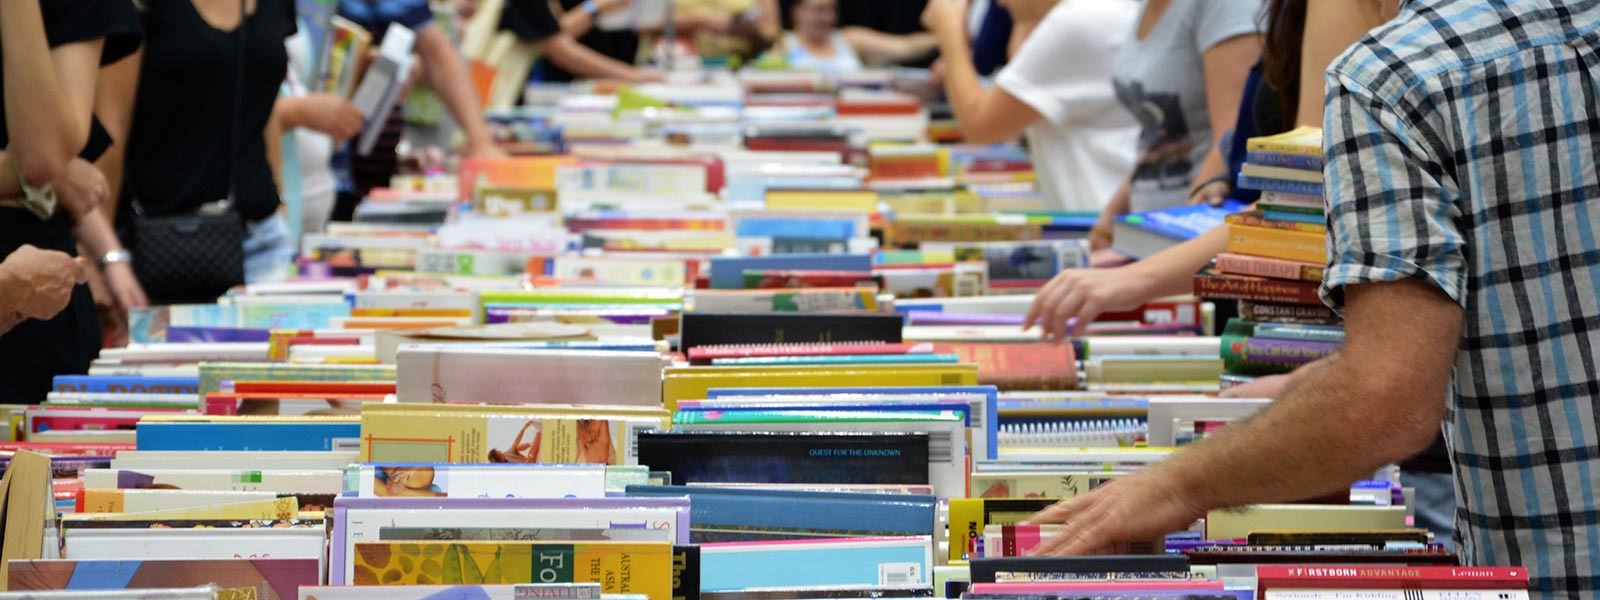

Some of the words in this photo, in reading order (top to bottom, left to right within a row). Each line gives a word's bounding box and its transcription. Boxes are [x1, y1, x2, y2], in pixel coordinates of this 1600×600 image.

[1220, 257, 1250, 272] ANGEL
[1252, 260, 1297, 278] THERAPY
[1200, 278, 1219, 290] The
[1220, 279, 1239, 290] Art
[1253, 304, 1295, 316] CONSTANT
[809, 448, 831, 457] QUEST
[833, 448, 847, 457] FOR
[849, 448, 862, 457] THE
[863, 448, 901, 457] UNKNOWN
[591, 558, 600, 575] THE
[1297, 568, 1357, 577] FIRSTBORN
[1360, 568, 1421, 577] ADVANTAGE
[605, 570, 615, 591] ASIA
[518, 586, 571, 599] LIVING
